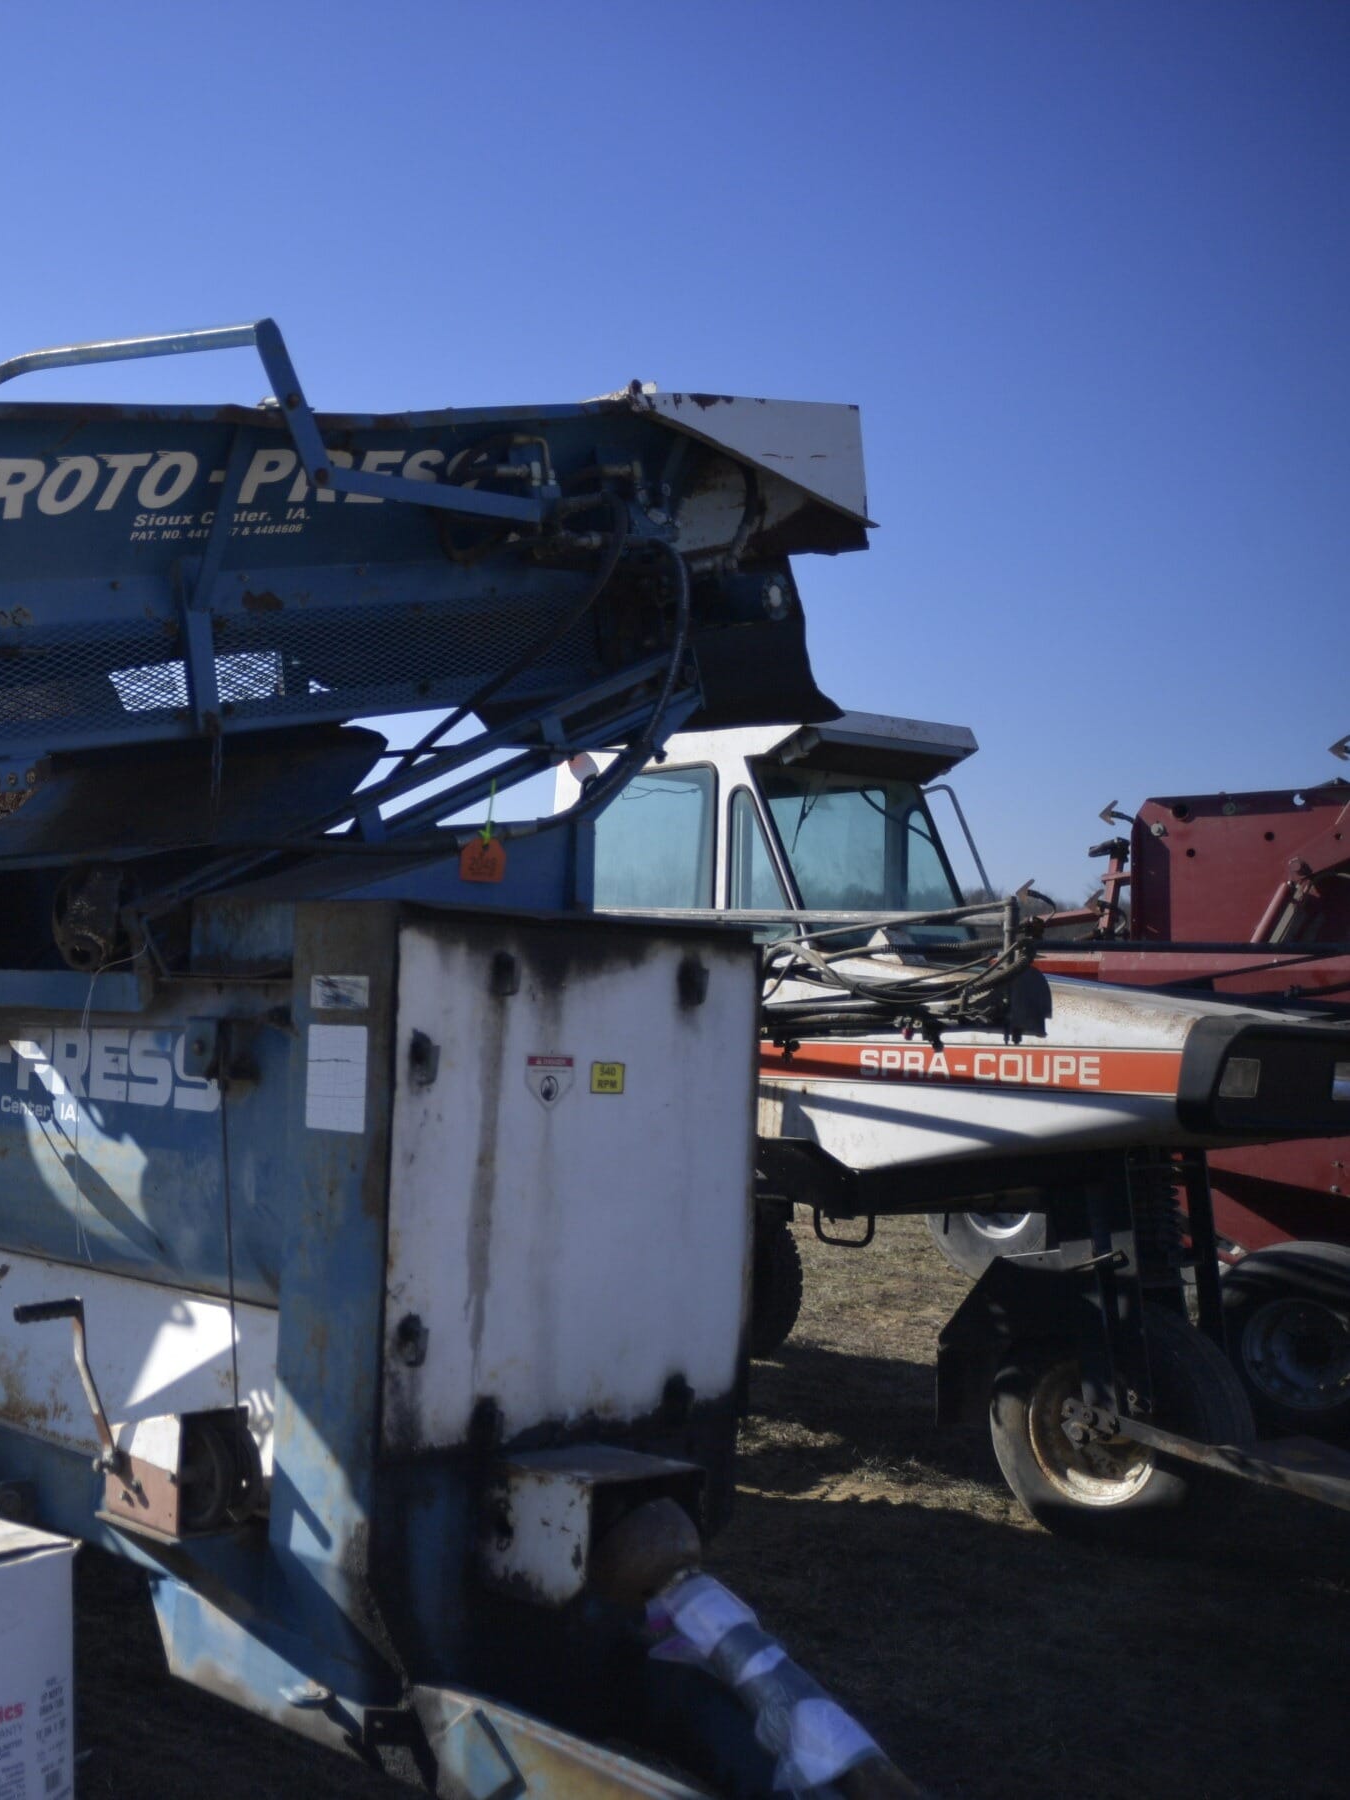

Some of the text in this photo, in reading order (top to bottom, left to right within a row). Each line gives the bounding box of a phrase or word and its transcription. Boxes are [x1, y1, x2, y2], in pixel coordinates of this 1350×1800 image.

[133, 513, 194, 528] Sioux
[129, 530, 157, 542] PAT.
[859, 1049, 1100, 1086] SPRA-COUPE
[597, 1078, 618, 1089] RPM
